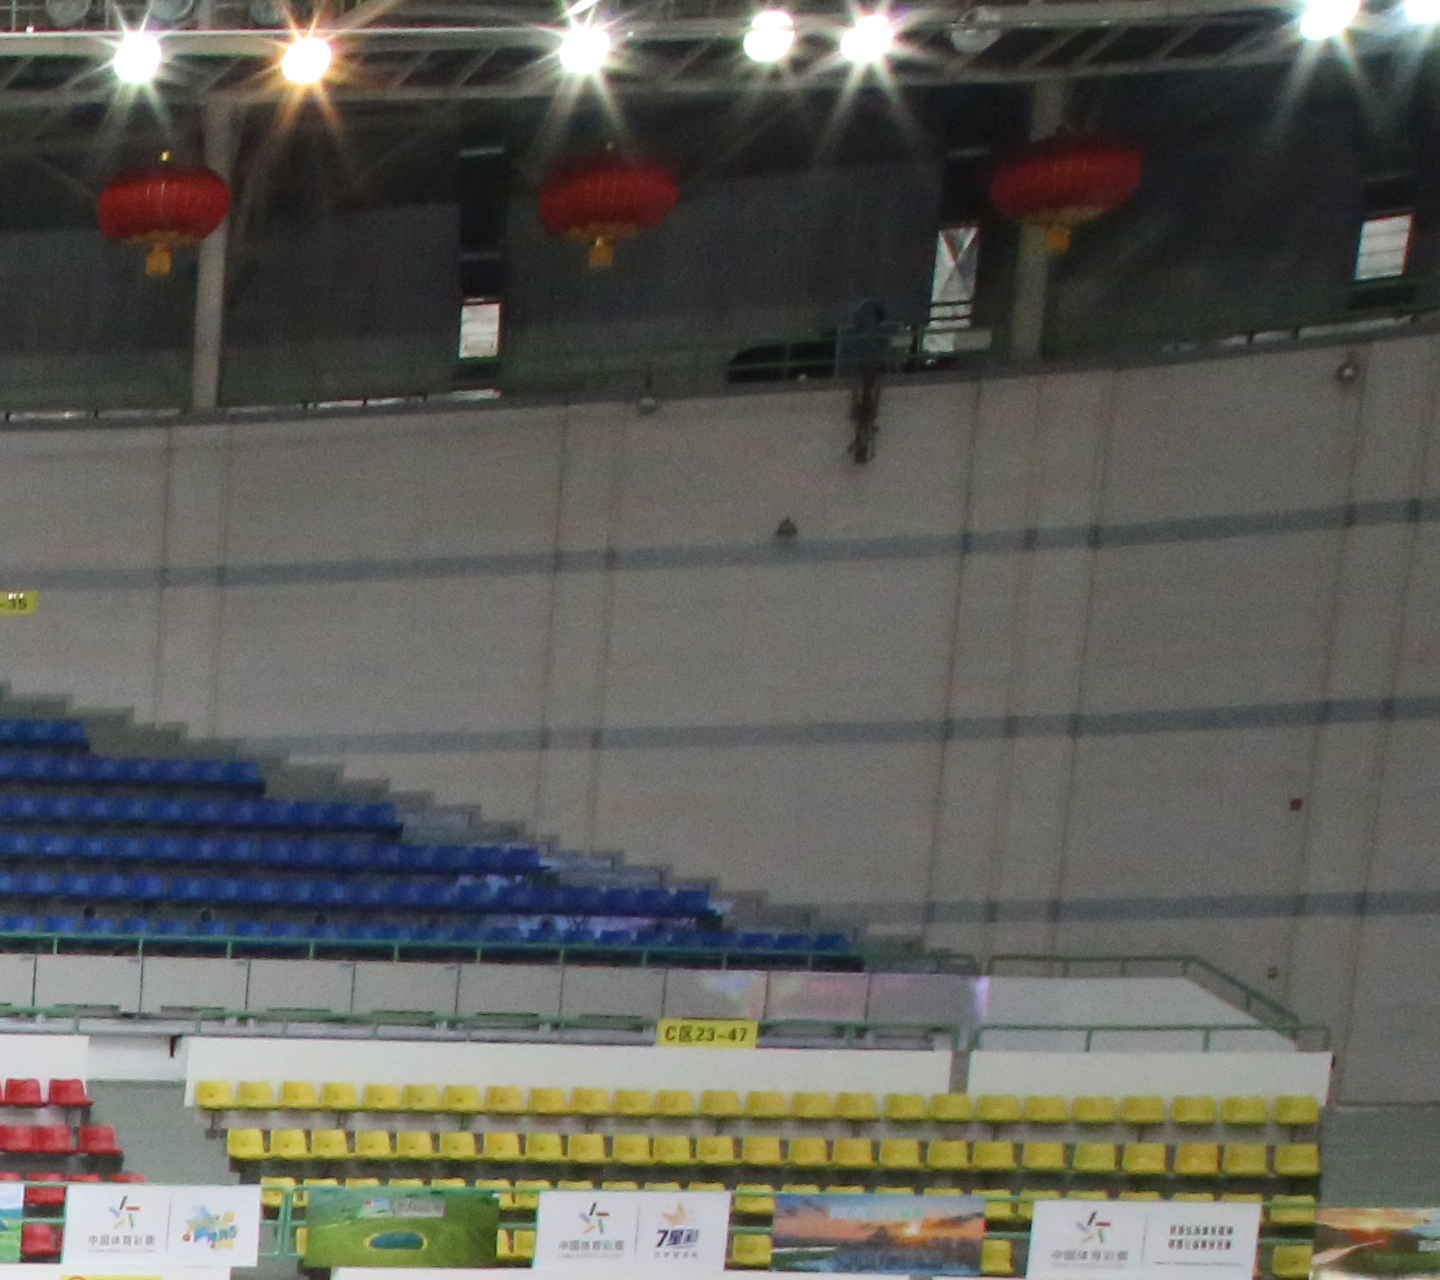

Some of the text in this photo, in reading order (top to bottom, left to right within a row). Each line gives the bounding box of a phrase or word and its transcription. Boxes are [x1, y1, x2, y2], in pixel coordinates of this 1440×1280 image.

[664, 1022, 749, 1045] C区23-47
[88, 1234, 155, 1246] 中国体育彩票
